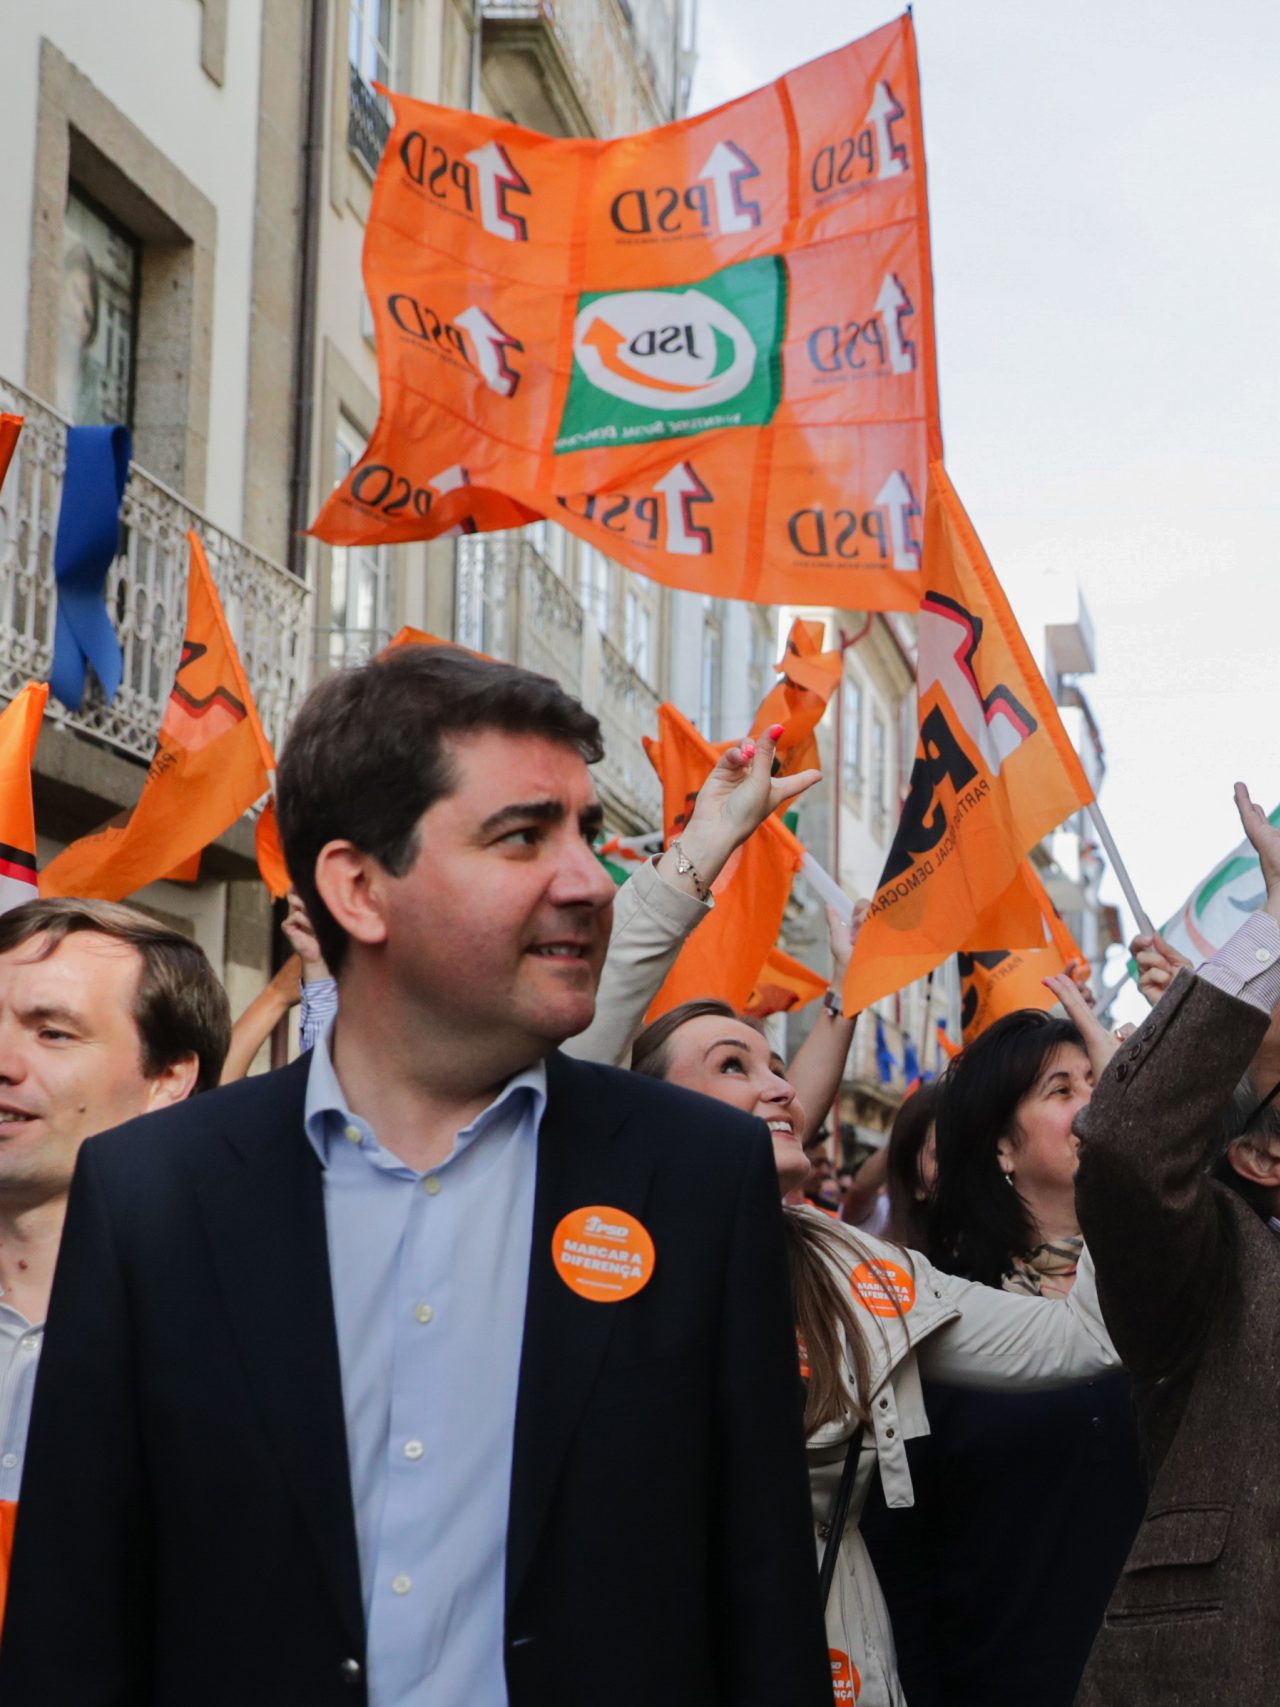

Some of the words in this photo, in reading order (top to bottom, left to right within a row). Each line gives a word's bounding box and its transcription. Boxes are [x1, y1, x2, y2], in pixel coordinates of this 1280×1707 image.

[564, 1239, 629, 1263] MARCAR
[561, 1251, 643, 1280] DIFERENÇA
[858, 1282, 900, 1293] MARAR
